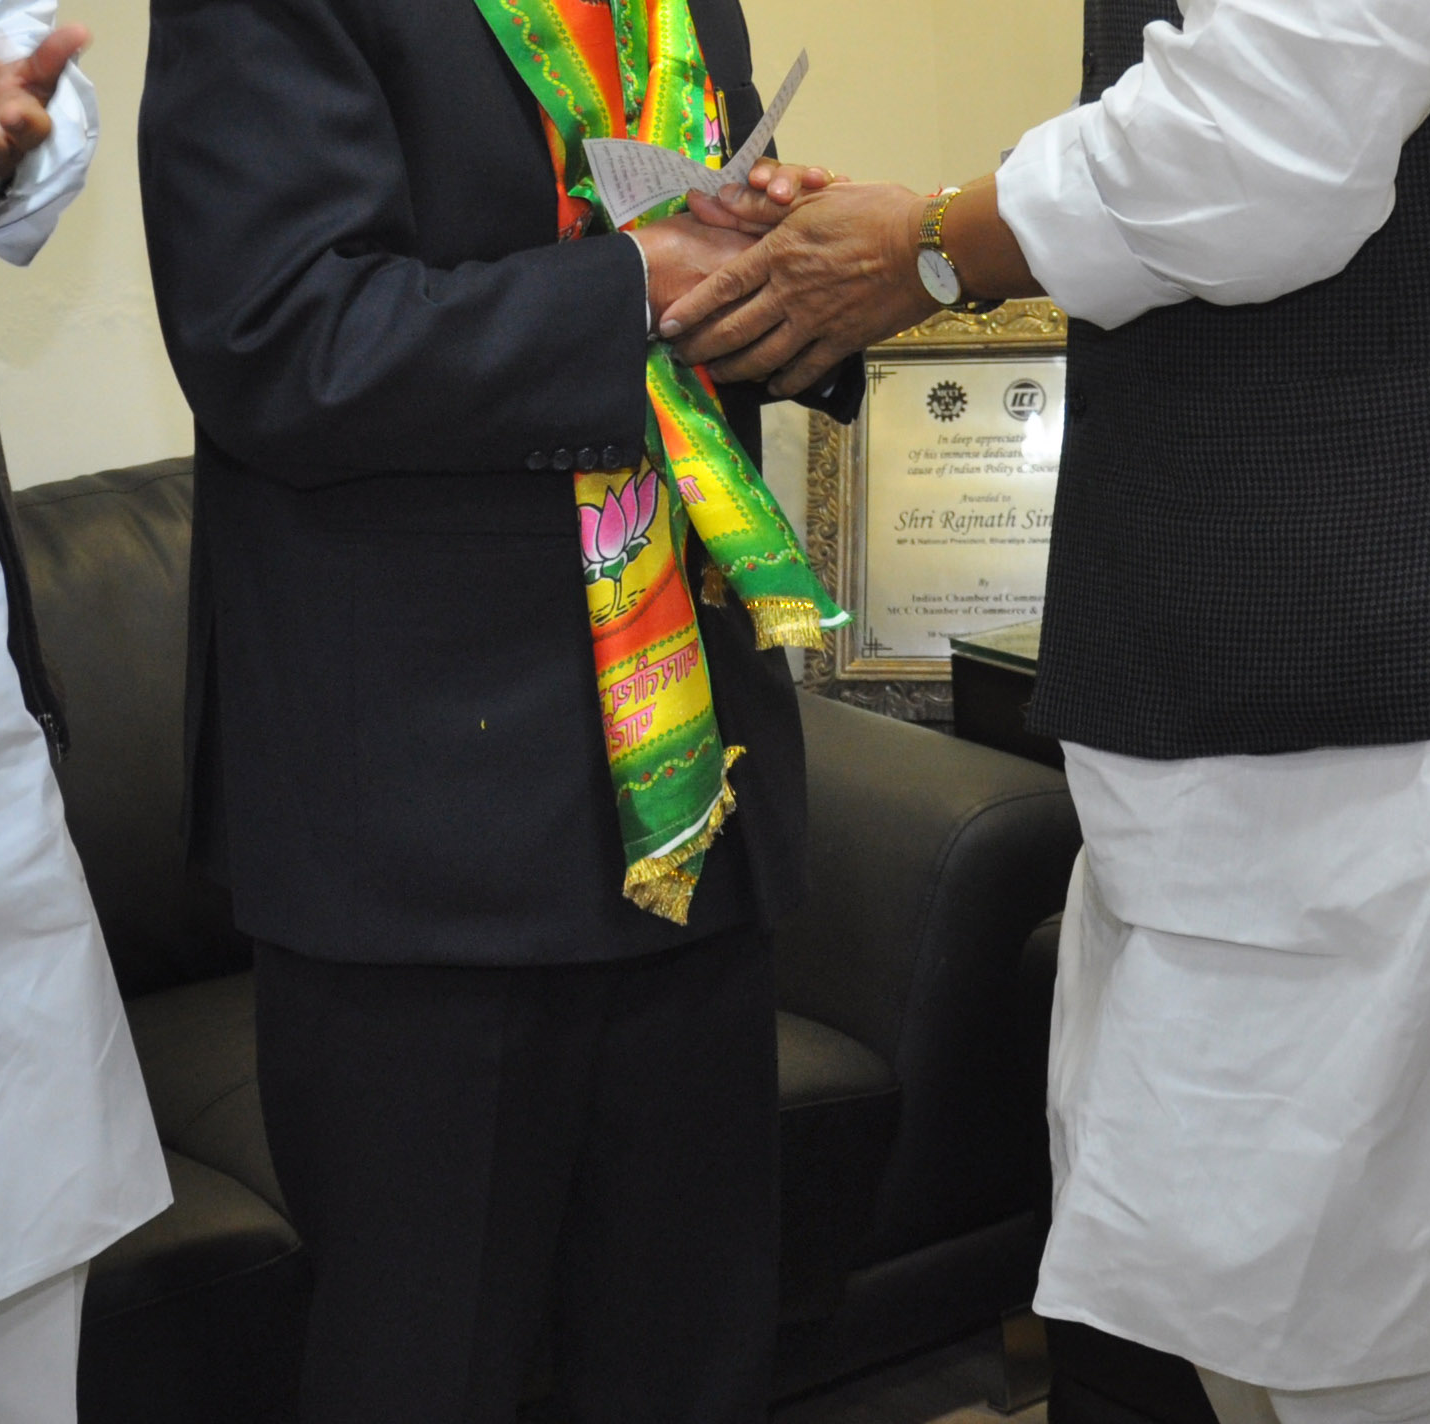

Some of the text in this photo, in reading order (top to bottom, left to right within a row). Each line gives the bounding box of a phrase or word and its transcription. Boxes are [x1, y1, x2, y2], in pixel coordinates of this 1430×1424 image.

[1011, 391, 1039, 408] ICC
[937, 434, 1026, 447] In deep appreciati
[908, 448, 1024, 463] Of his immense dedicati
[907, 467, 933, 476] cause
[935, 464, 946, 478] of
[949, 464, 981, 475] Indian
[984, 464, 1014, 477] Polity
[961, 494, 1011, 504] Awarded to
[894, 507, 1053, 536] Shri Rajnath Sin
[978, 578, 990, 588] By
[911, 594, 942, 602] Indian
[945, 594, 989, 602] Chamber
[992, 594, 1003, 602] of
[887, 606, 1038, 615] MCC Chamber of Commerce &
